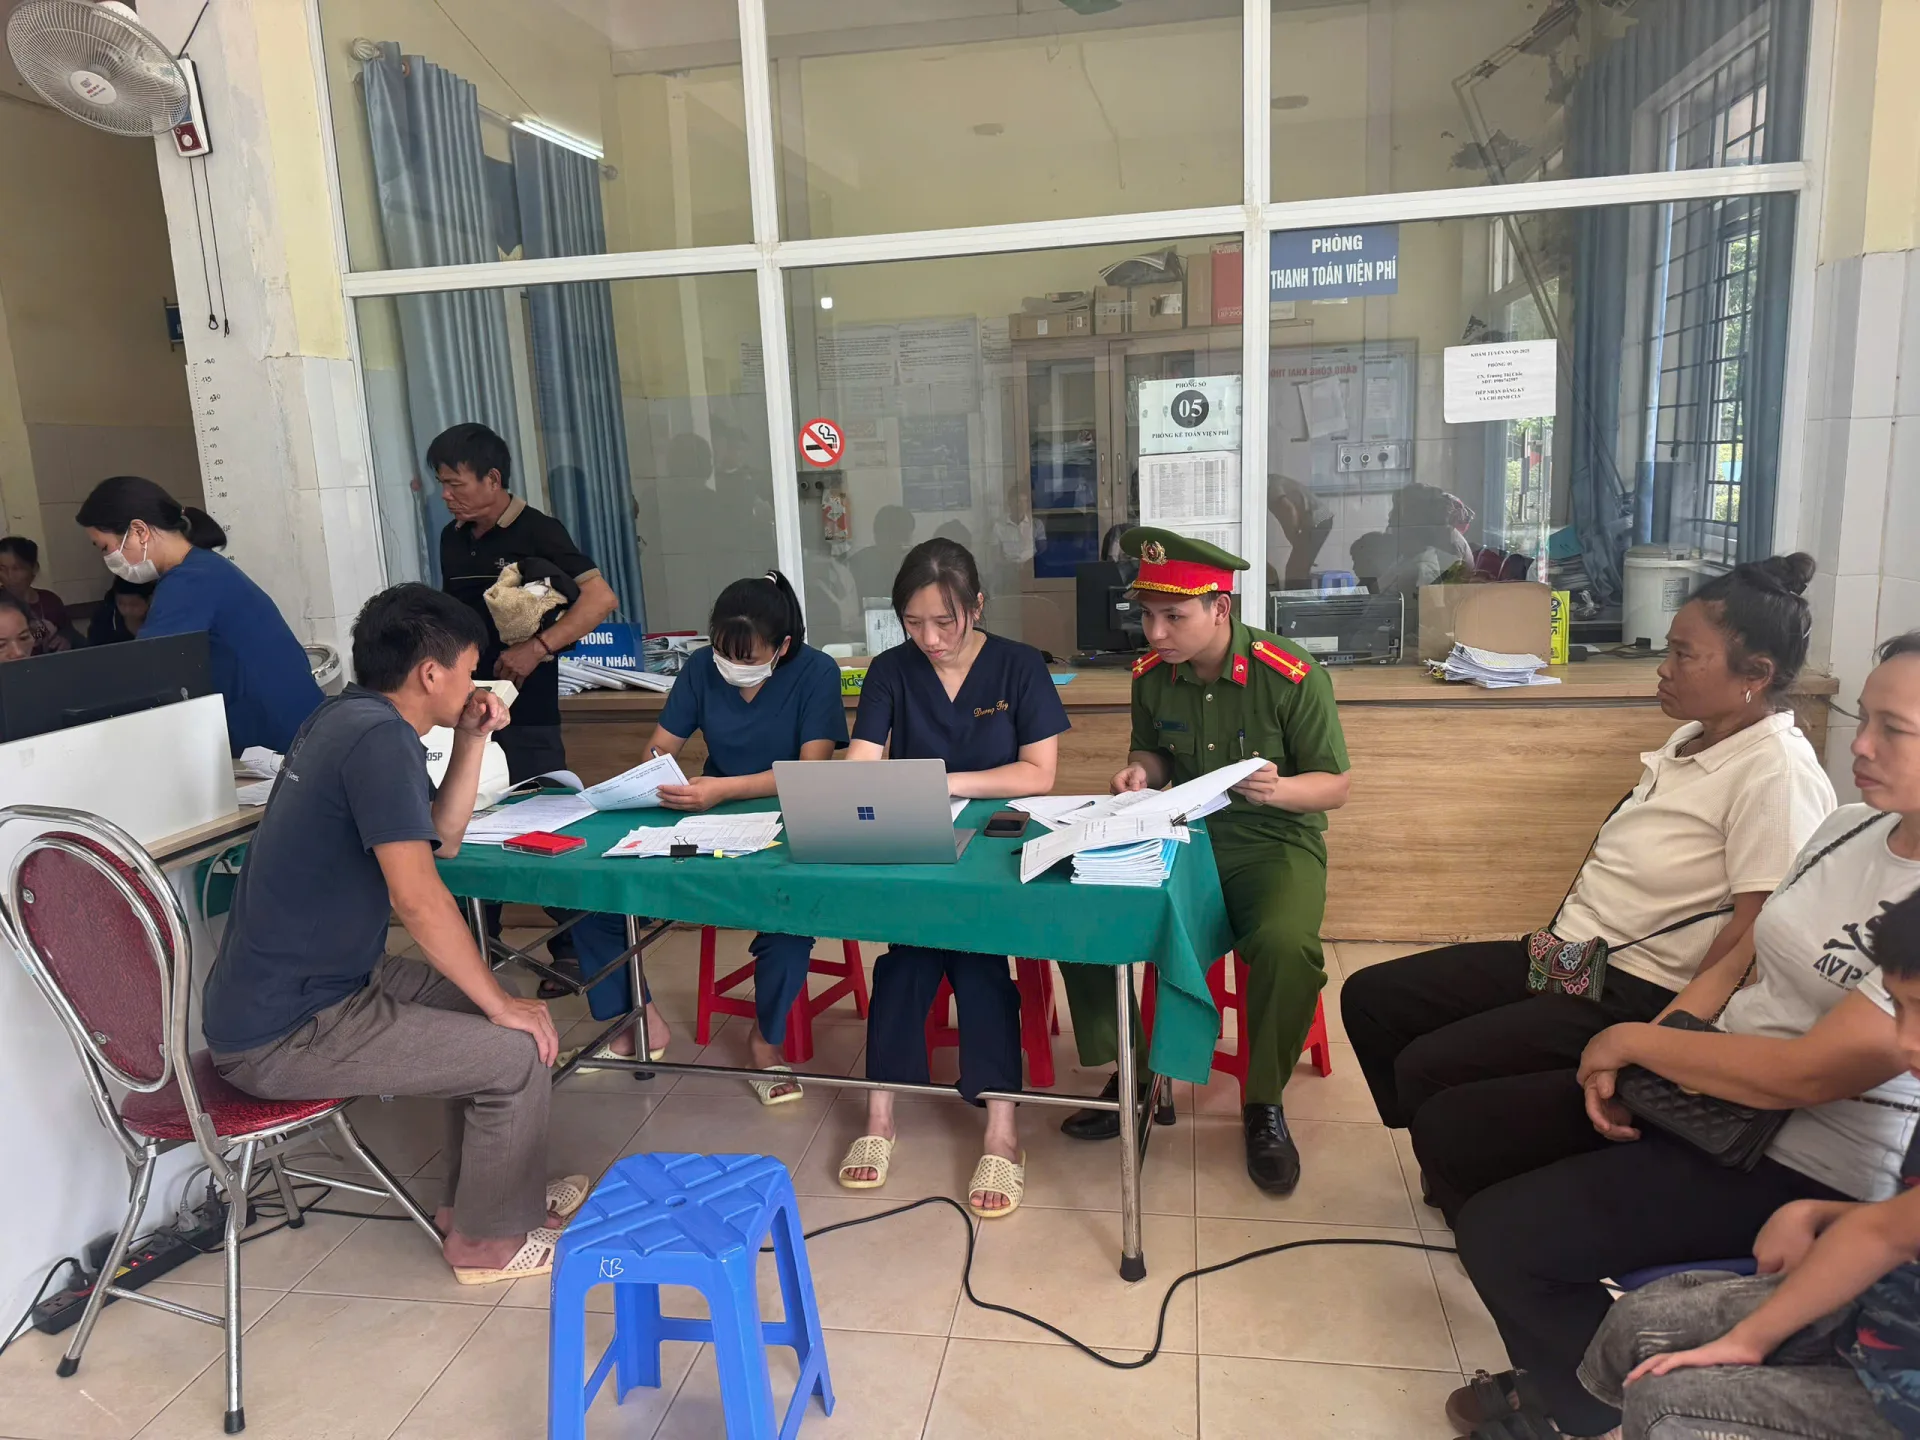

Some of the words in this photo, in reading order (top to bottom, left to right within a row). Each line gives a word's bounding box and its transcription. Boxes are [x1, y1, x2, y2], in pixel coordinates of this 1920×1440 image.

[1311, 233, 1363, 254] PHÒNG
[1270, 267, 1309, 290] THANH
[1311, 261, 1343, 286] TOÁN
[1346, 259, 1373, 286] VIỆN
[1376, 255, 1397, 281] PHÍ
[1175, 381, 1197, 389] PHÒNG
[1178, 398, 1203, 418] 05
[1184, 430, 1201, 438] TOÁN
[1202, 430, 1217, 438] VIỆN
[1218, 428, 1229, 436] PHÍ
[605, 653, 636, 668] NHÂN
